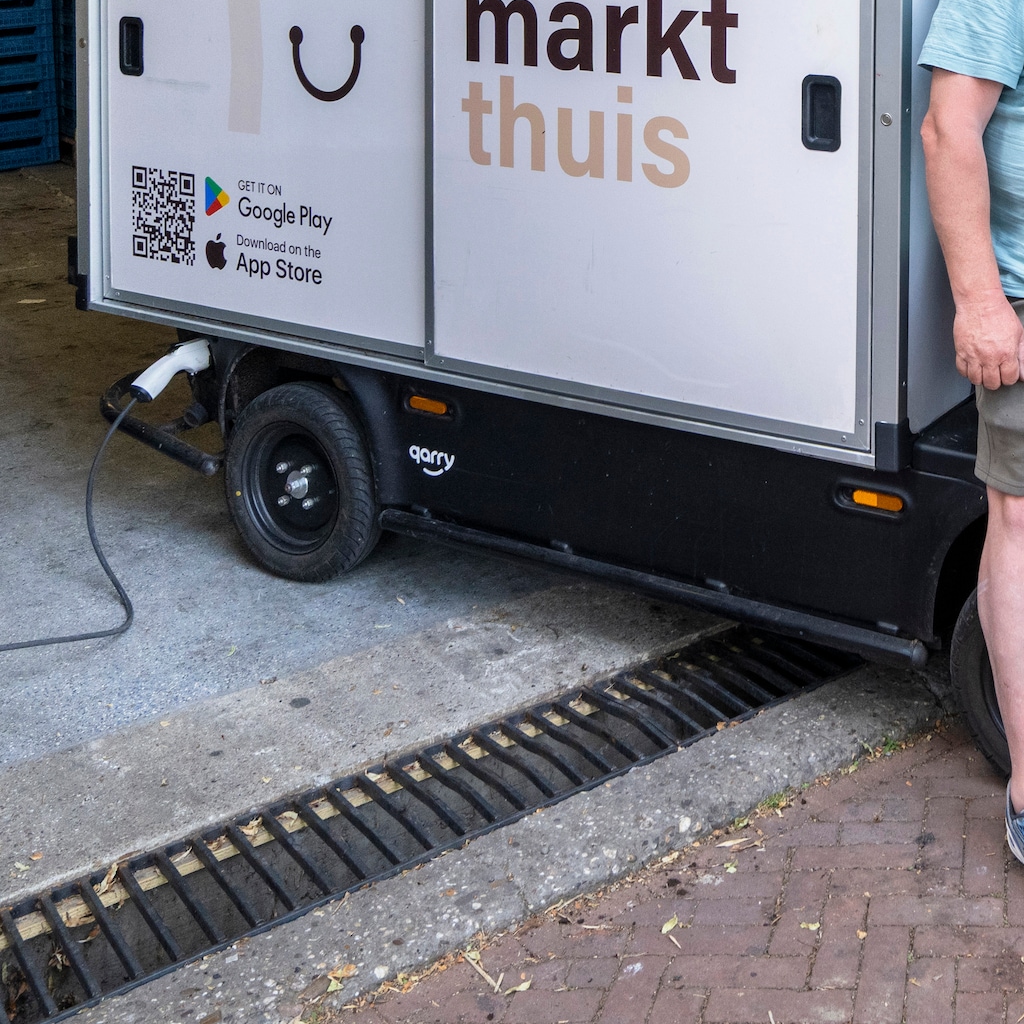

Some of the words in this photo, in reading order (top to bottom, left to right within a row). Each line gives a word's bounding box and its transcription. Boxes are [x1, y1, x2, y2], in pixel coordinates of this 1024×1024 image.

[461, 74, 691, 189] thuis
[238, 179, 256, 193] GET
[257, 182, 266, 194] IT
[267, 183, 282, 196] ON
[238, 196, 296, 228] Google
[300, 205, 333, 236] Play
[236, 234, 286, 253] Download
[288, 245, 302, 256] on
[304, 245, 321, 259] the
[236, 252, 271, 280] App
[275, 258, 323, 285] Store
[408, 444, 456, 472] qarry
